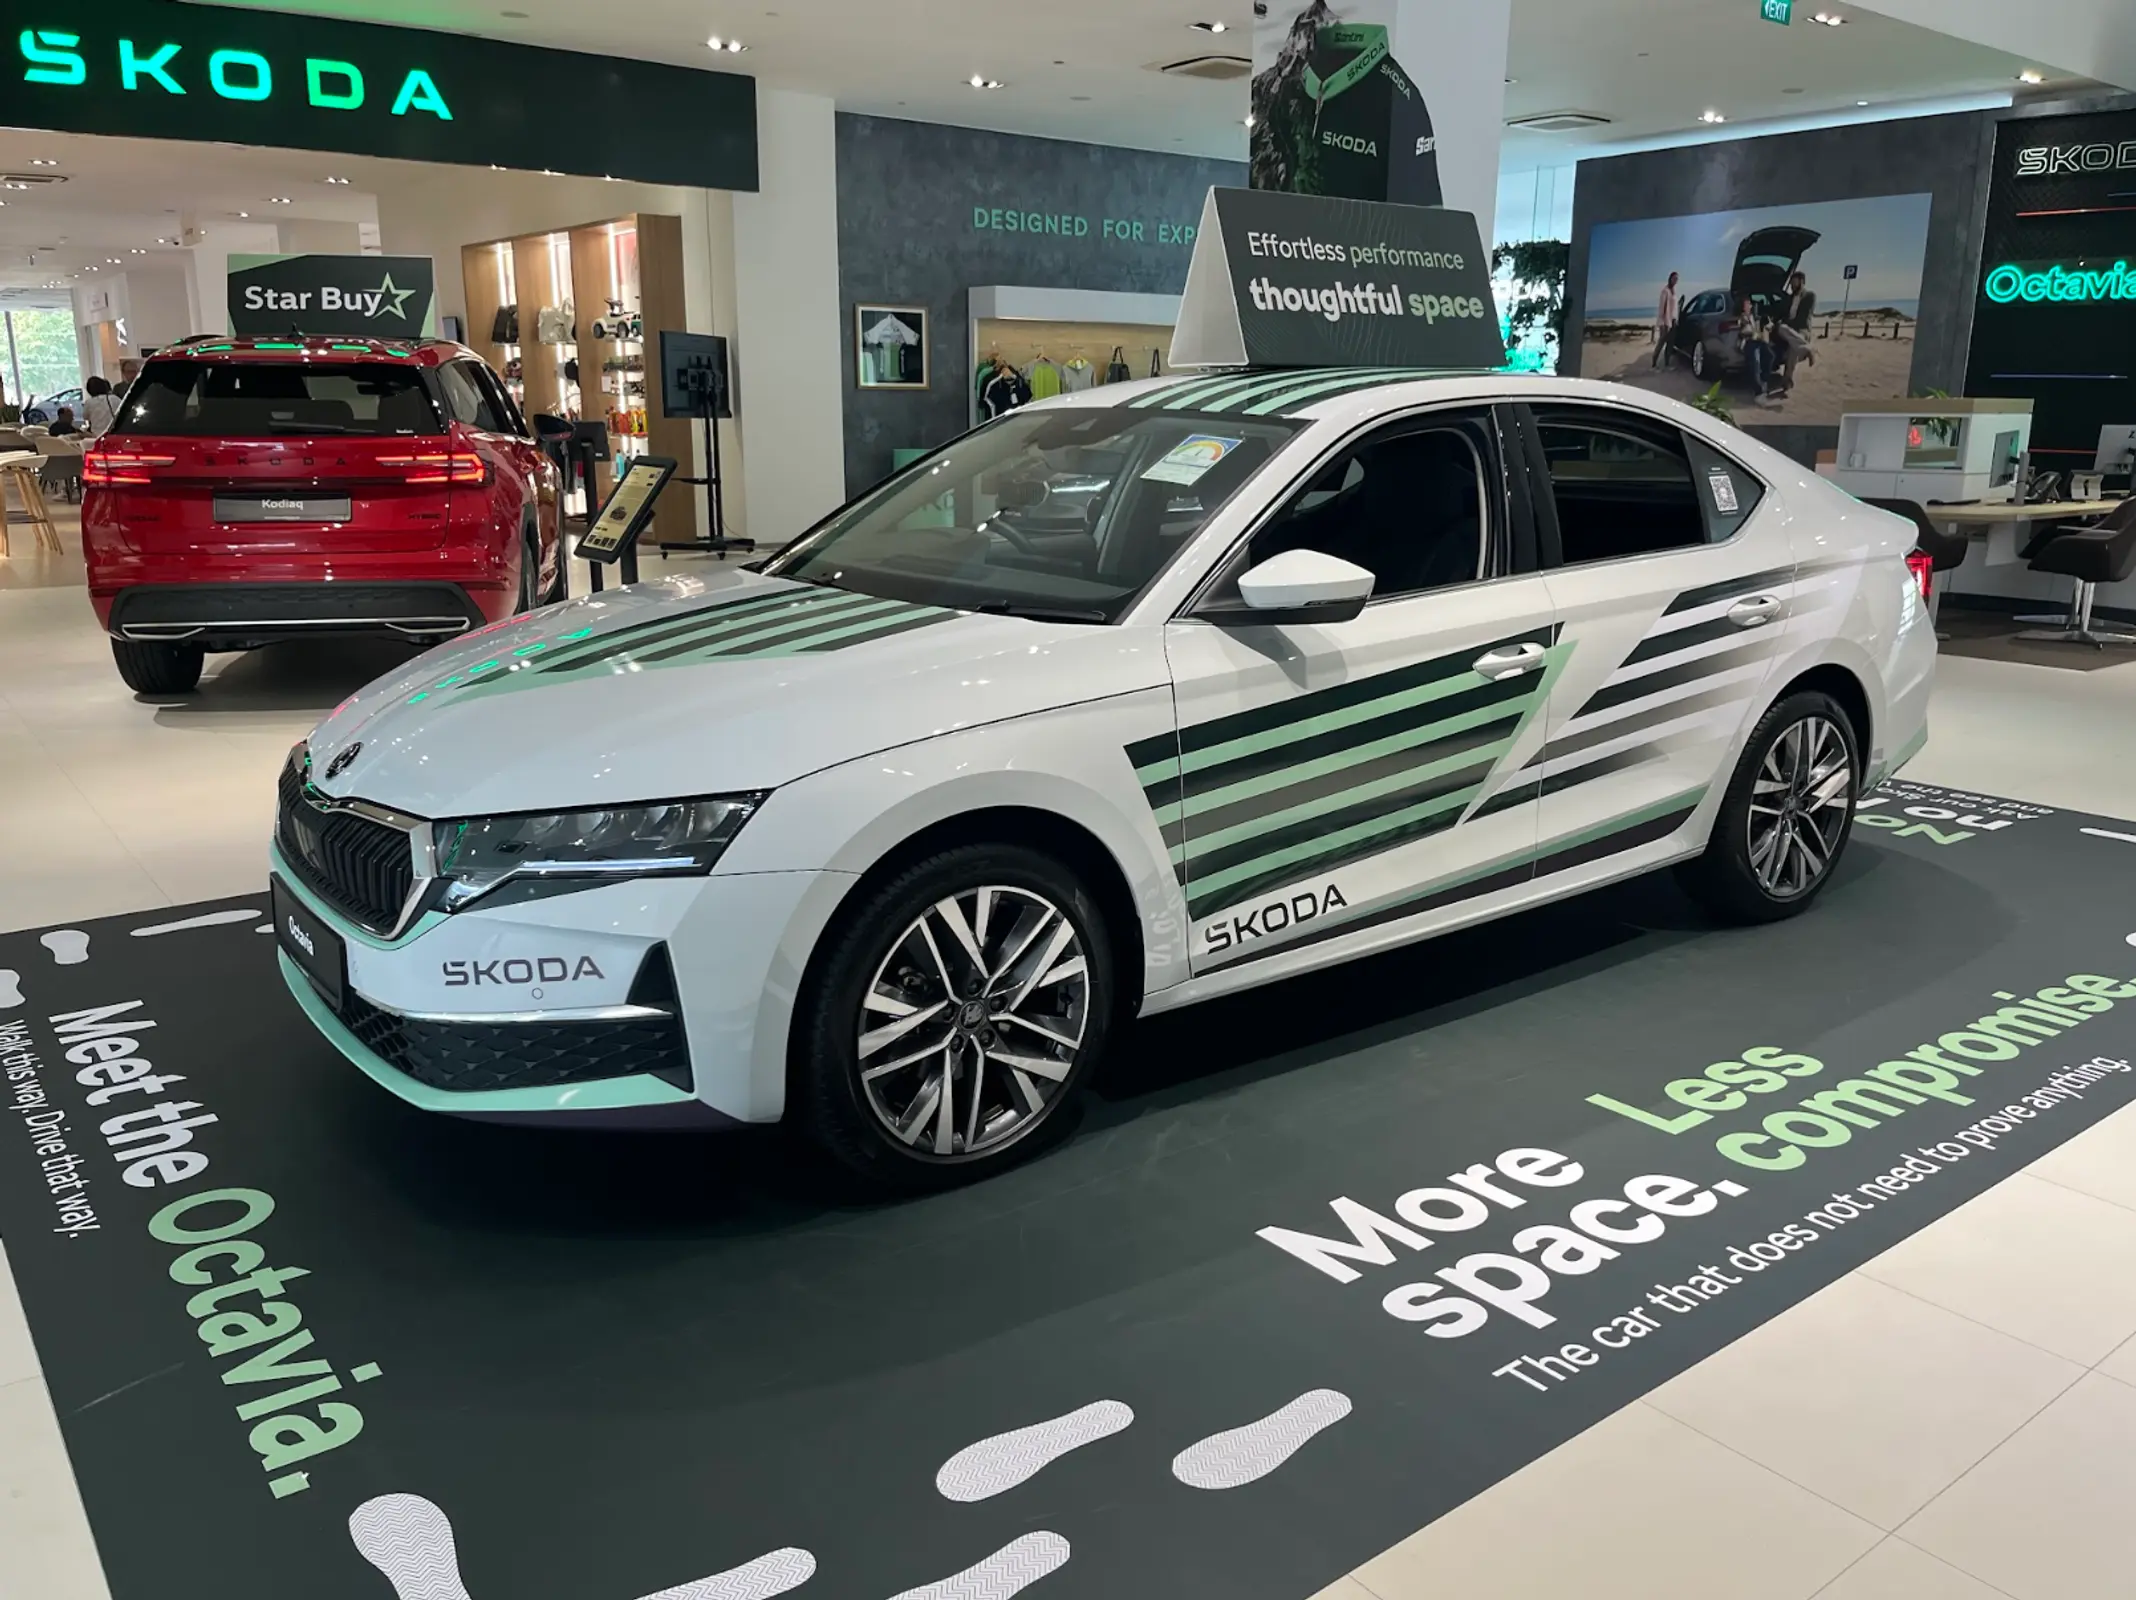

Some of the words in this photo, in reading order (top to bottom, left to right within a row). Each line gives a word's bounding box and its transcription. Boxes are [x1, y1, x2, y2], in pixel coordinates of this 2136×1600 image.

[1768, 0, 1788, 21] EXIT
[19, 29, 454, 121] SKODA
[1346, 41, 1385, 81] SKODA
[1380, 63, 1411, 100] SKODA
[1322, 131, 1377, 157] SKODA
[2016, 140, 2136, 175] SKOD
[973, 207, 1088, 236] DESIGNED
[1103, 219, 1144, 241] FOR
[1158, 224, 1199, 244] EXP
[1247, 232, 1346, 262] Effortless
[1350, 242, 1464, 270] performance
[244, 286, 312, 310] Star
[321, 287, 382, 317] Buy
[1249, 277, 1404, 322] thoughtful
[1408, 293, 1485, 325] space
[1985, 259, 2136, 304] Octavia
[262, 499, 304, 510] Kodiaq
[288, 915, 315, 957] Octavia
[1205, 884, 1348, 955] SKODA
[443, 955, 606, 987] SKODA
[0, 1019, 33, 1056] Walk
[49, 1000, 187, 1106] Meet
[3, 1053, 44, 1081] this
[9, 1079, 49, 1114] way.
[1584, 1046, 1824, 1135] Less
[25, 1110, 71, 1156] Drive
[100, 1101, 219, 1188] the
[41, 1154, 90, 1194] that
[53, 1192, 100, 1238] way.
[1255, 1147, 1584, 1284] More
[1491, 1343, 1599, 1392] The
[1592, 1306, 1661, 1348] car
[1646, 1264, 1743, 1313] that
[1726, 1223, 1819, 1272] does
[1803, 1193, 1875, 1230] not
[1856, 1153, 1942, 1201] need
[1917, 1141, 1970, 1163] to
[1954, 1103, 2037, 1150] prove
[2021, 1056, 2132, 1110] anything.
[1383, 1174, 1750, 1339] space.
[148, 1187, 383, 1499] Octavia.
